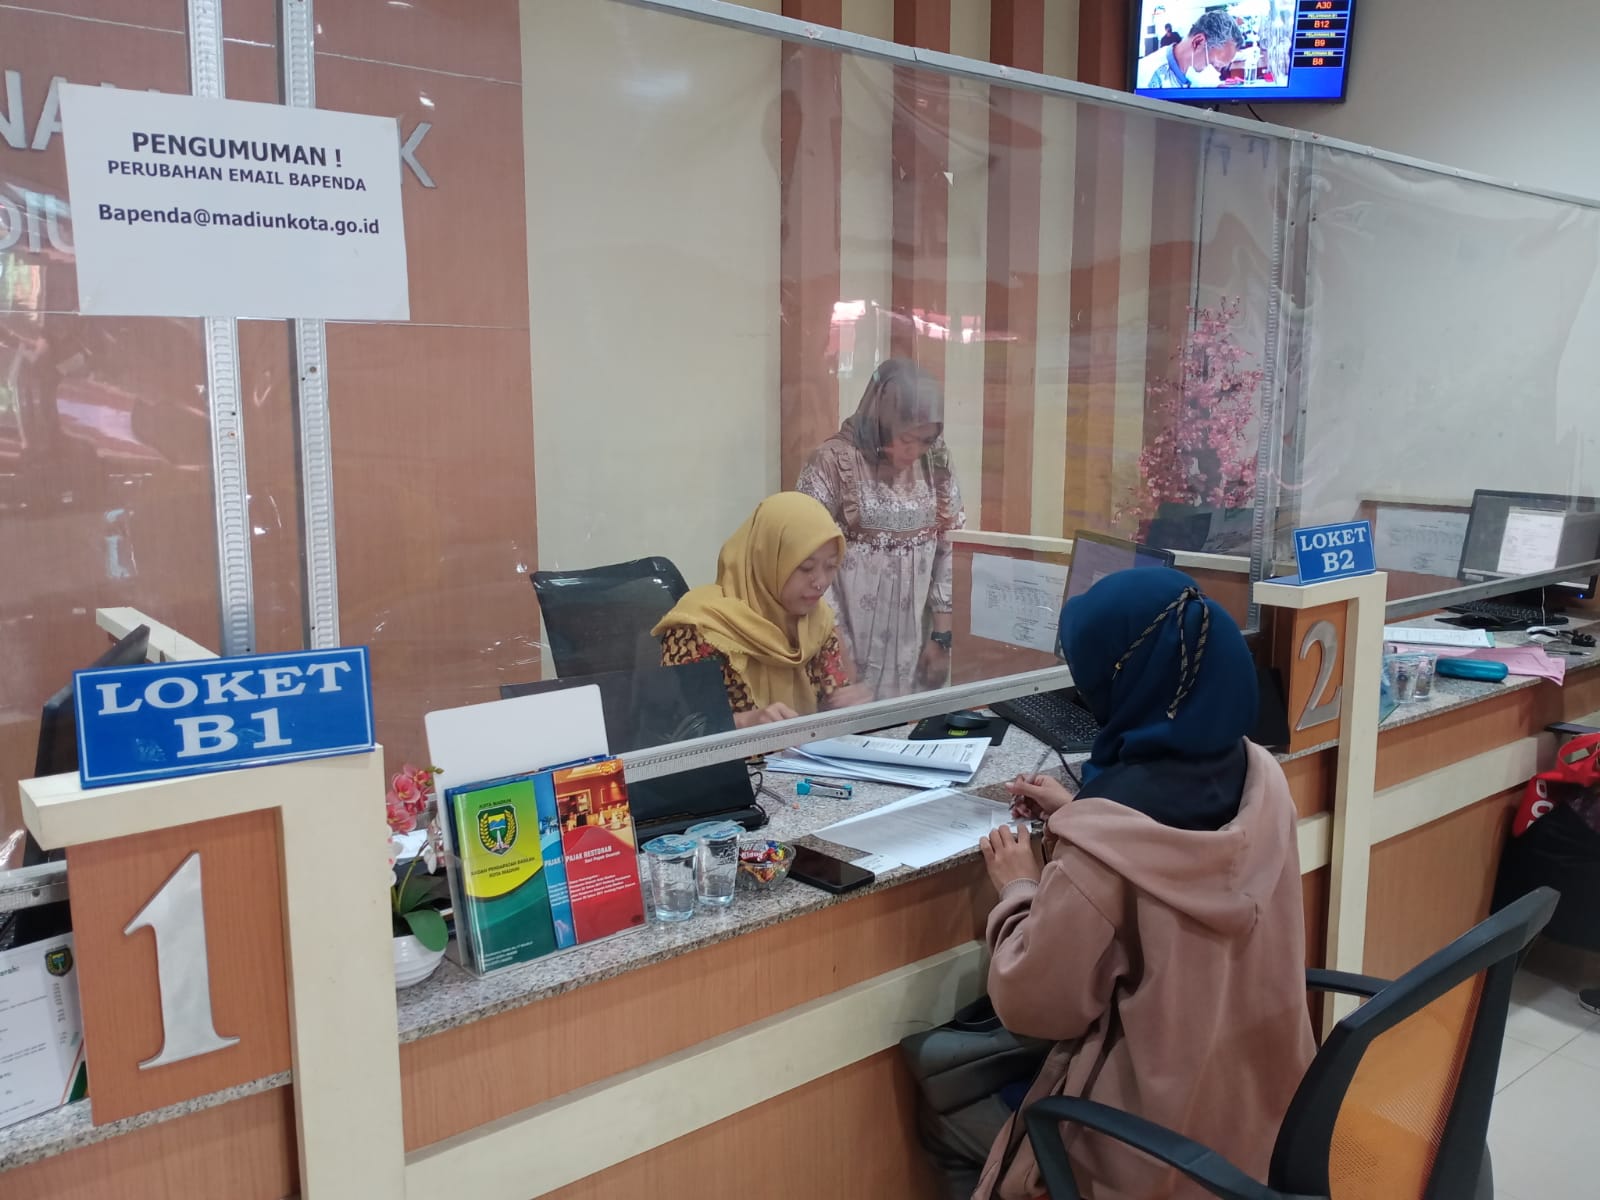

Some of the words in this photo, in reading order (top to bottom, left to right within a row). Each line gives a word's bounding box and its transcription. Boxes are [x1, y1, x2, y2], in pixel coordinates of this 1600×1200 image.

[1315, 1, 1332, 9] A30
[1314, 20, 1330, 28] B12
[132, 131, 327, 167] PENGUMUMAN
[335, 148, 342, 168] !
[108, 160, 223, 181] PERUBAHAN
[228, 167, 284, 185] EMAIL
[288, 172, 367, 191] BAPENDA
[98, 203, 380, 236] Bapenda@madiunkota.go.id
[1299, 526, 1368, 552] LOKET
[1320, 549, 1356, 573] B2
[96, 661, 352, 716] LOKET
[1296, 619, 1342, 732] 2
[174, 707, 292, 759] B1
[123, 850, 241, 1070] 1
